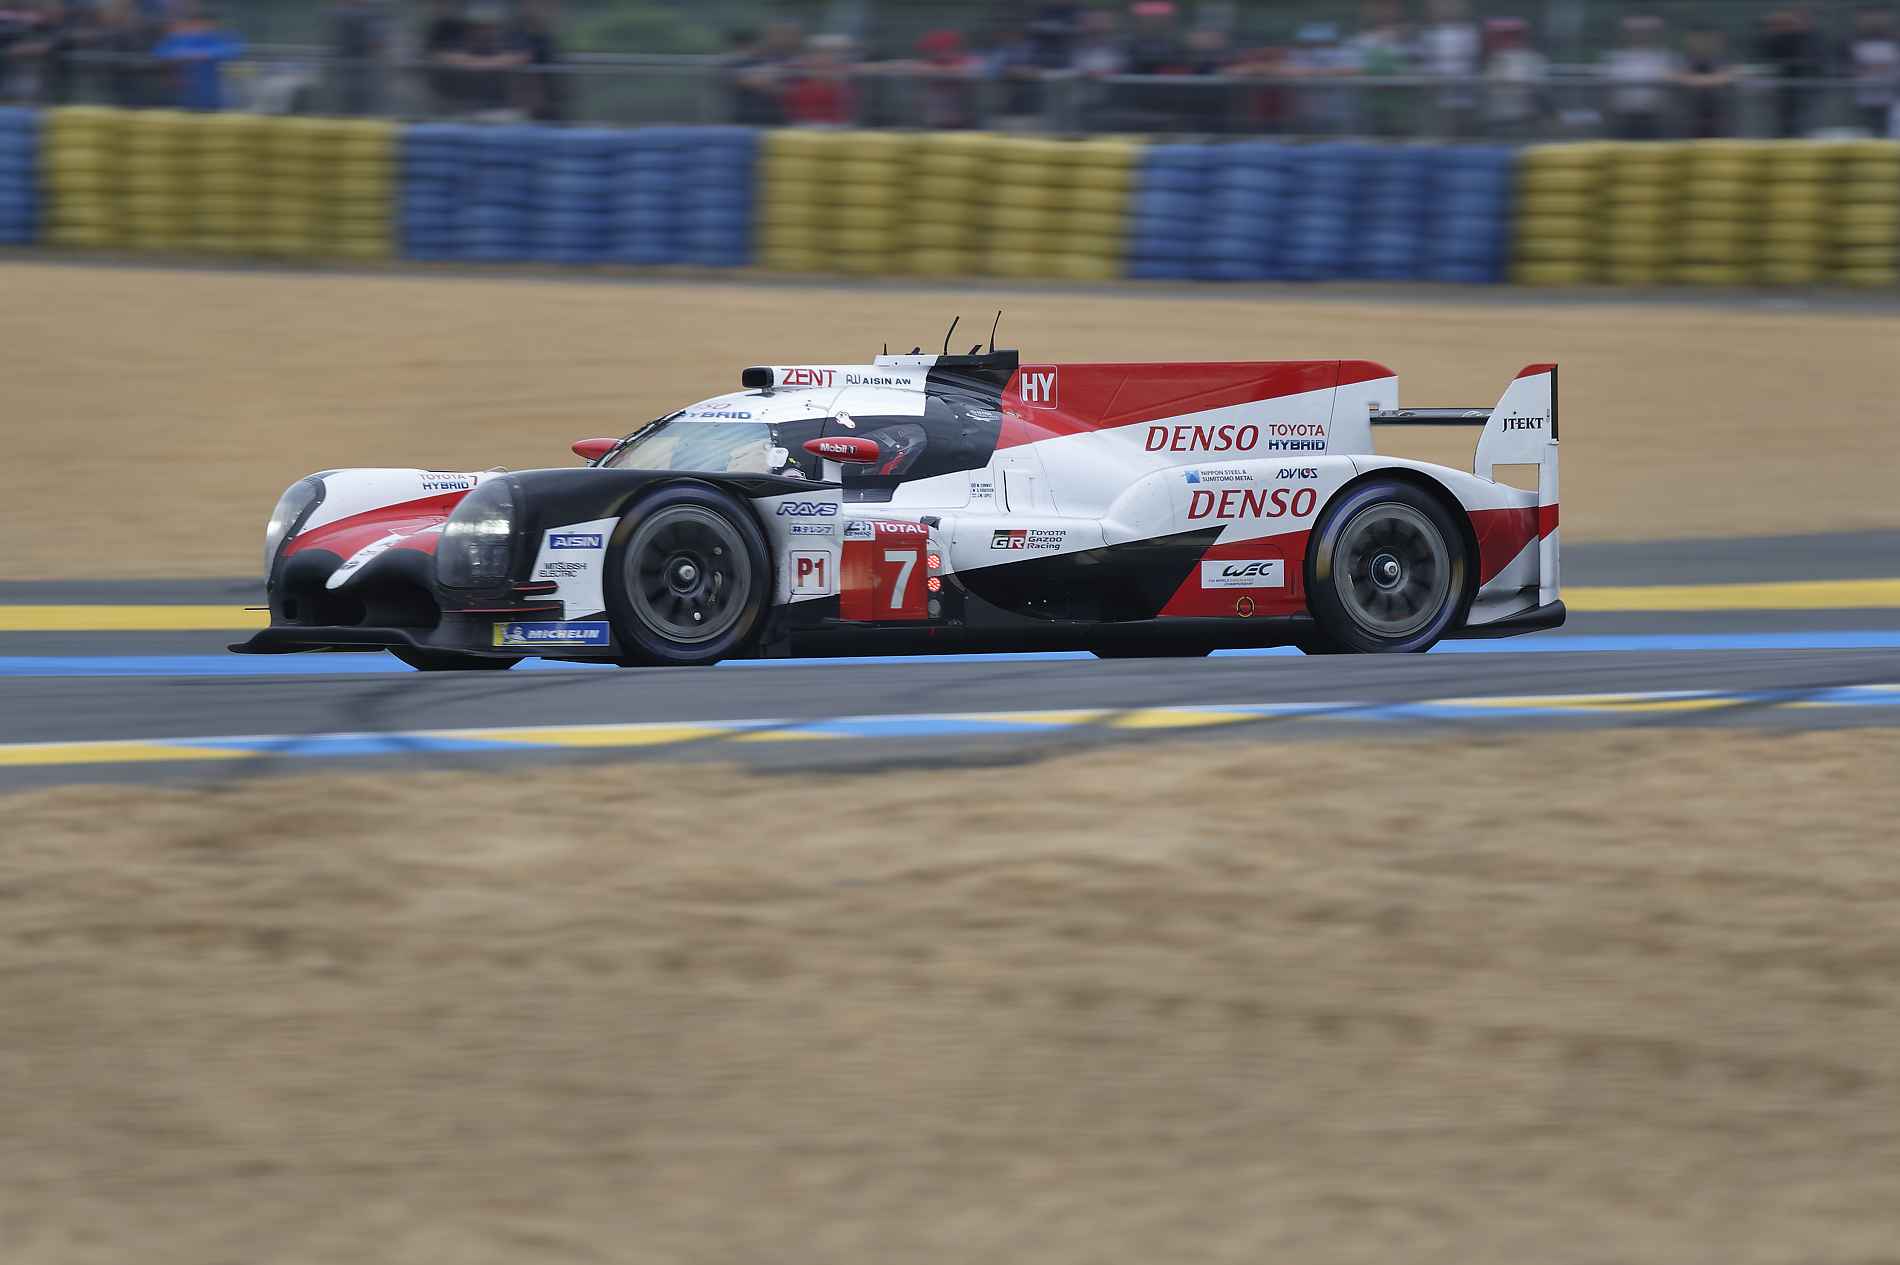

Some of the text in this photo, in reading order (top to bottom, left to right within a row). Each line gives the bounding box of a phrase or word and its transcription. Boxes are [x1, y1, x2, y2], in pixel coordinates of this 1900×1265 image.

[781, 368, 837, 388] ZENT
[862, 377, 892, 385] AISIN
[1021, 373, 1055, 402] HY
[1268, 424, 1325, 437] TOYOTA
[1502, 417, 1544, 433] JTEKT
[1144, 424, 1260, 452] DENSO
[820, 442, 848, 454] Mobil
[1268, 439, 1326, 451] HYBRID
[1275, 467, 1318, 480] ADVICS
[422, 481, 470, 490] HYBRID
[776, 501, 838, 516] RAYS
[1187, 487, 1318, 520] DENSO
[874, 521, 928, 534] TOTAL
[552, 536, 600, 547] AISIN
[991, 536, 1026, 550] GR
[1027, 543, 1061, 551] Racing
[797, 557, 825, 588] P1
[1222, 562, 1274, 577] WEC
[884, 550, 918, 609] 7
[527, 629, 600, 639] MICHELIN
